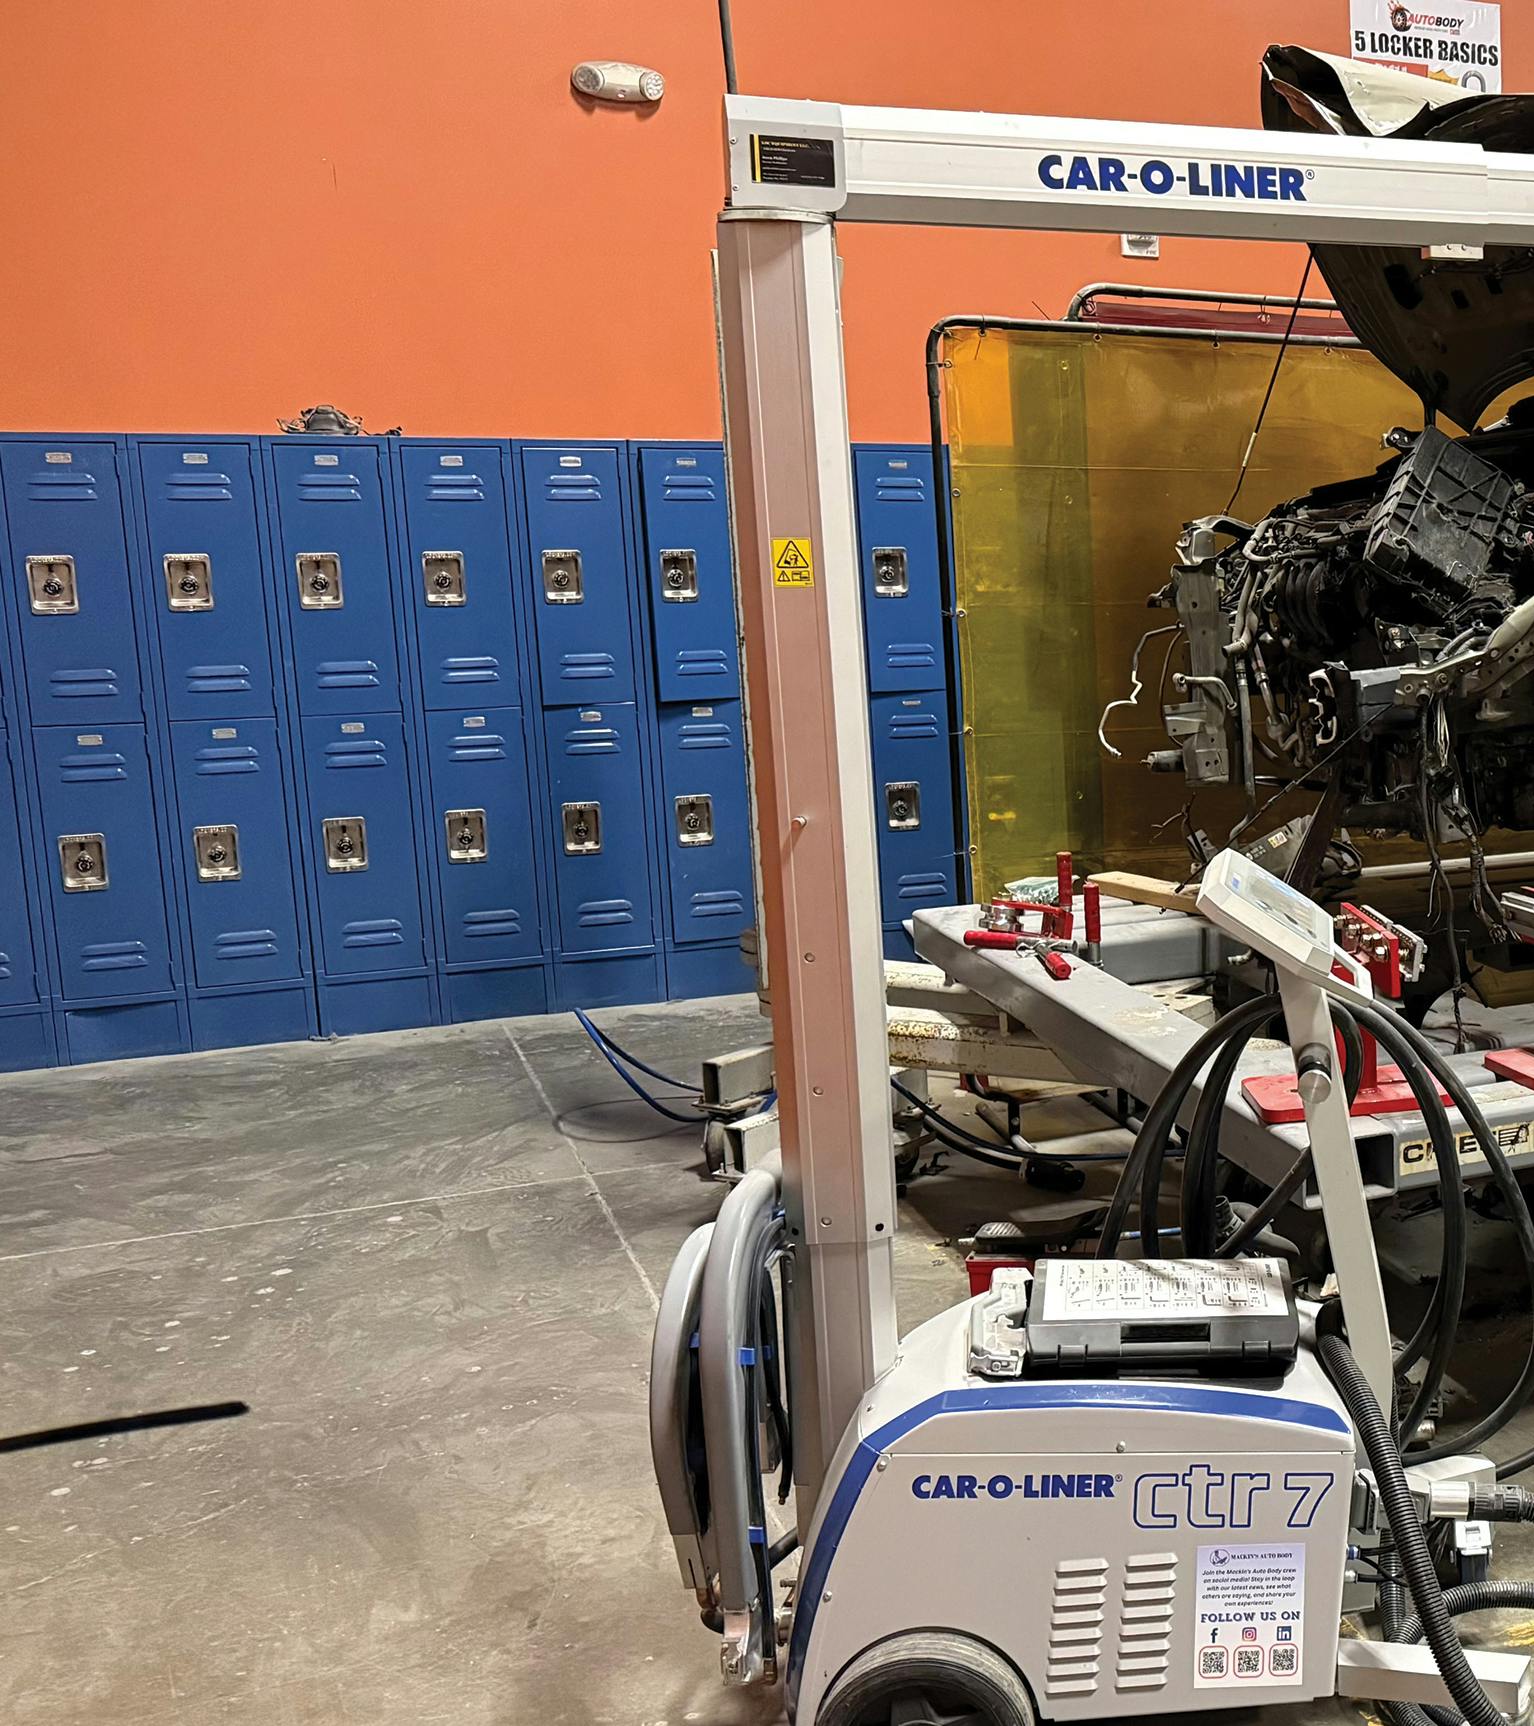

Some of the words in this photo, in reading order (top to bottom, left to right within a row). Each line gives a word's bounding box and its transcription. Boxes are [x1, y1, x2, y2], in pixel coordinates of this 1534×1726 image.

[1407, 13, 1464, 28] AUTOBODY
[1354, 30, 1366, 52] 5
[1370, 32, 1433, 59] LOCKER
[1438, 40, 1498, 66] BASICS
[1133, 1464, 1270, 1528] ctr
[1284, 1473, 1334, 1528] 7
[1201, 1612, 1255, 1623] FOLLOW
[1260, 1612, 1276, 1621] US
[1281, 1611, 1301, 1620] ON
